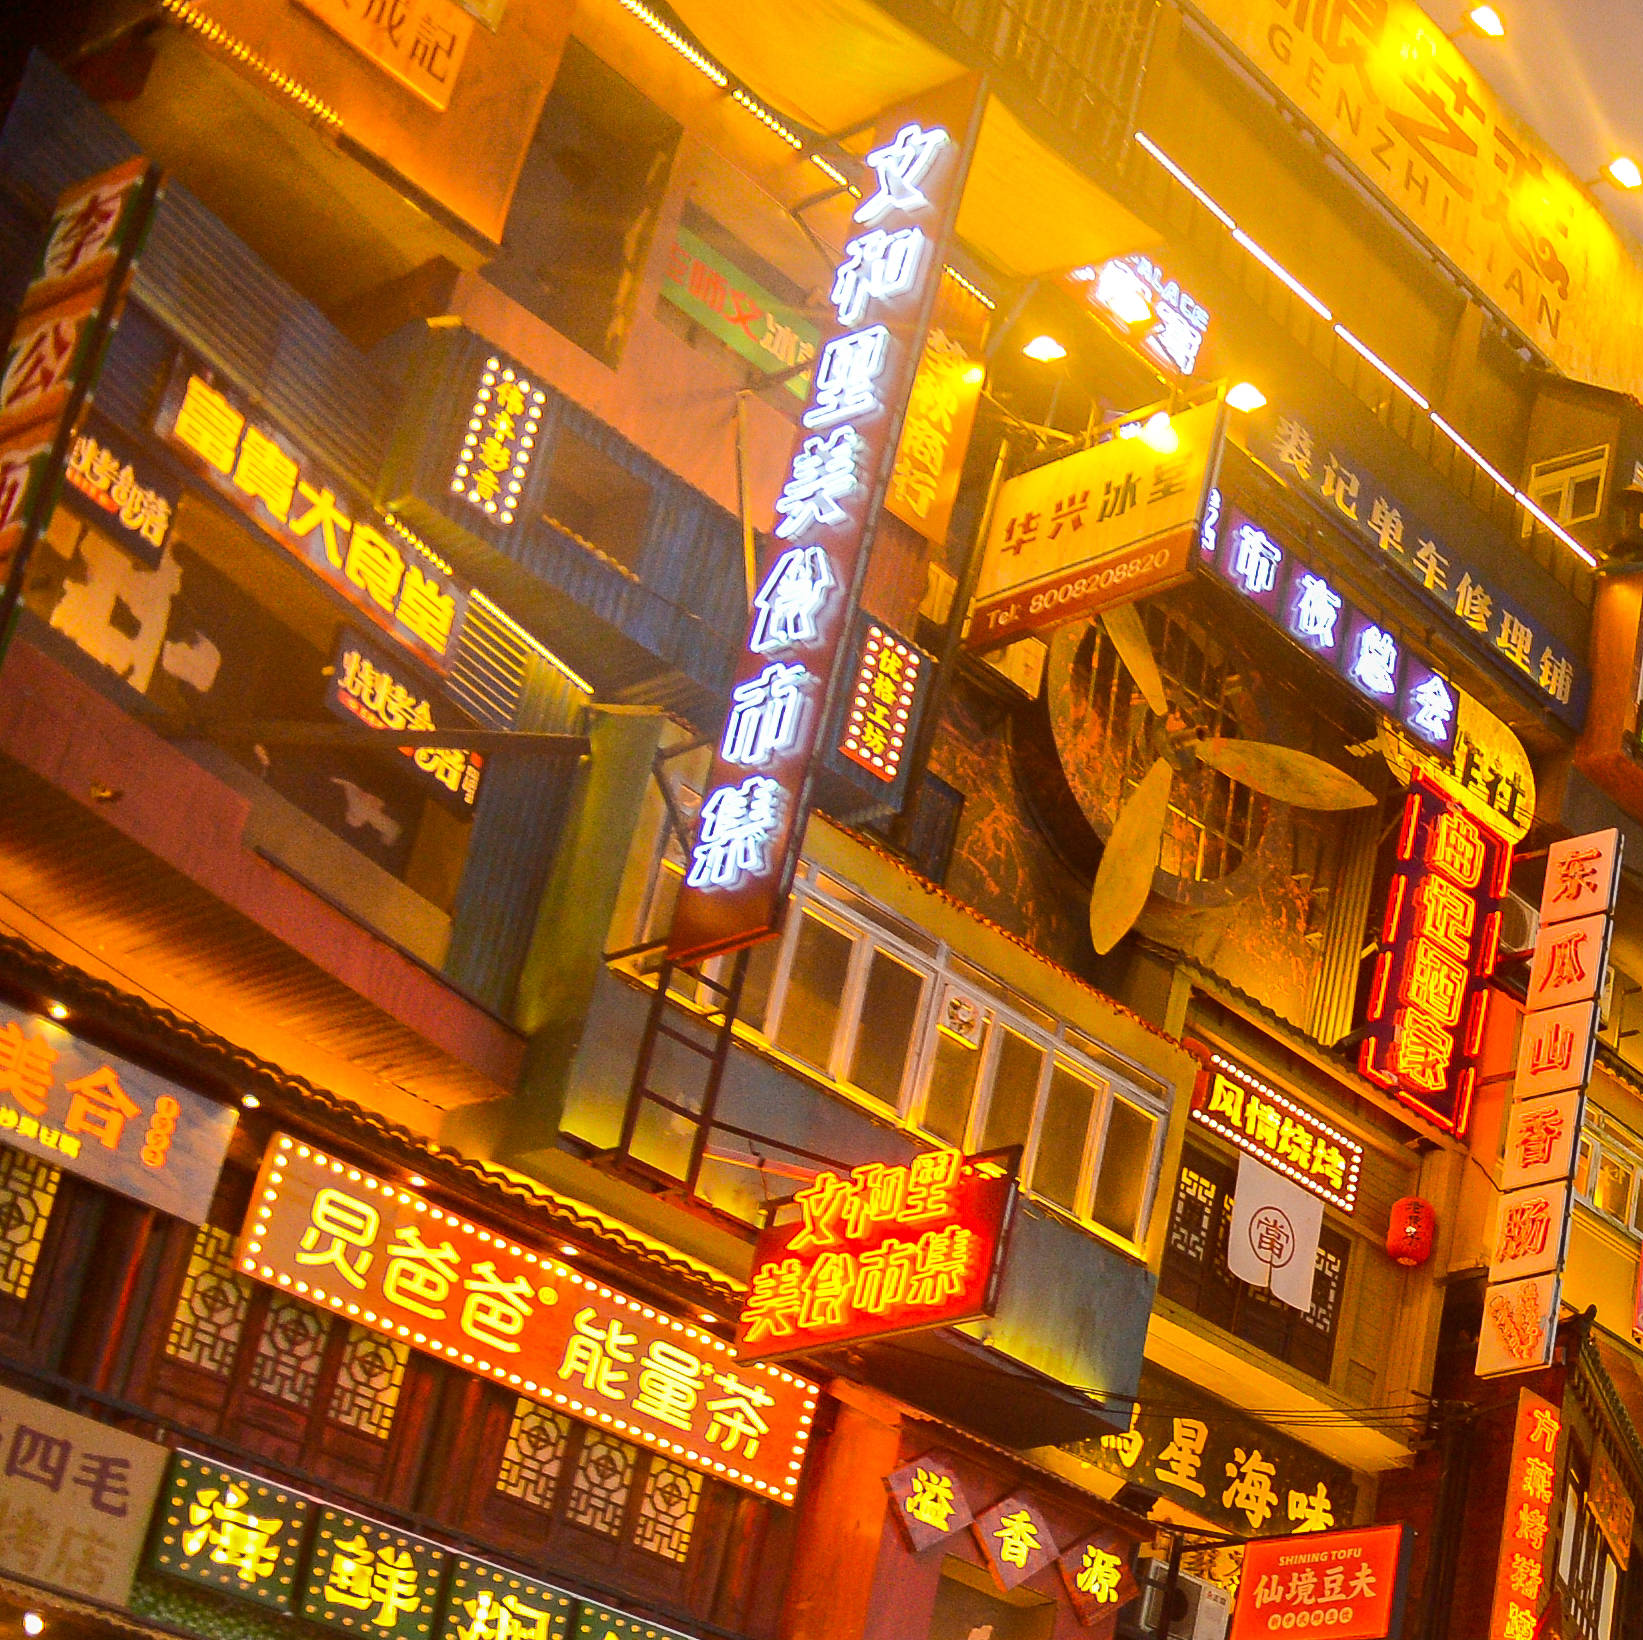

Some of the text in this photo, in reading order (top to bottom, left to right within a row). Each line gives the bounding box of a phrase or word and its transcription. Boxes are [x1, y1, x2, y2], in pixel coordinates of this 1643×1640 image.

[1029, 548, 1171, 615] 8008208820
[557, 1305, 775, 1461] 能量茶
[1330, 1546, 1362, 1563] TOFU
[1253, 1562, 1379, 1607] 仙境豆夫
